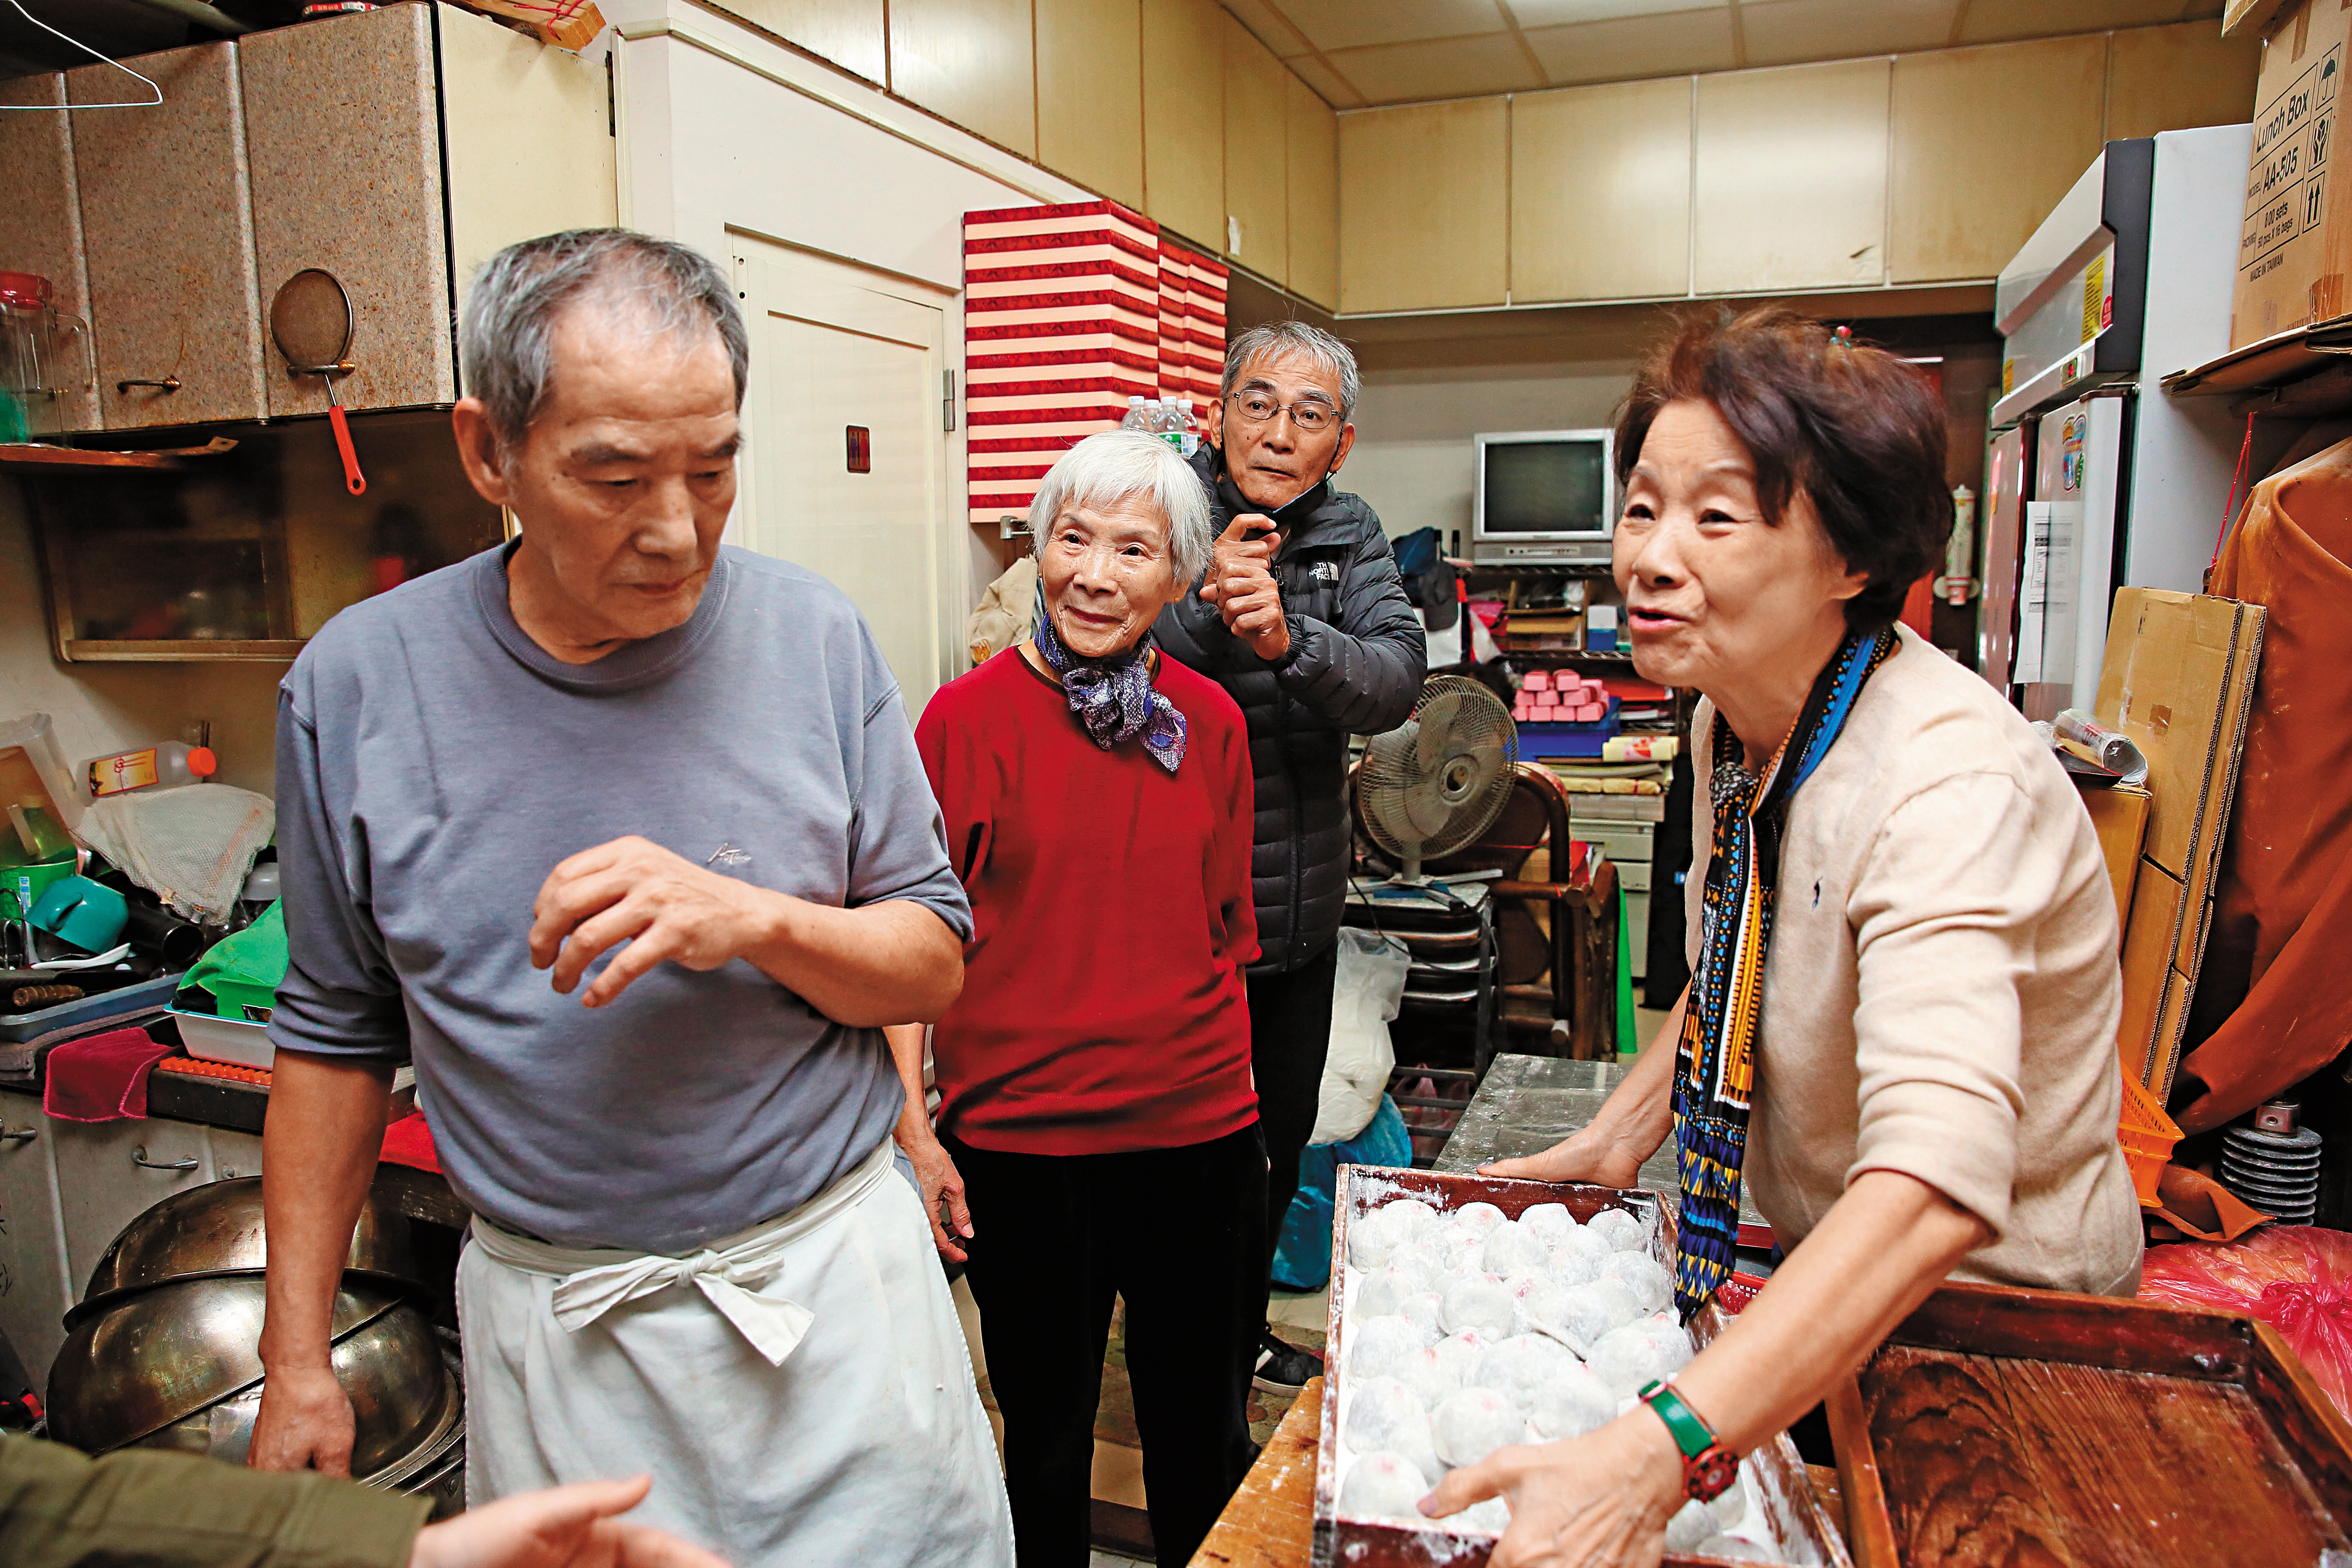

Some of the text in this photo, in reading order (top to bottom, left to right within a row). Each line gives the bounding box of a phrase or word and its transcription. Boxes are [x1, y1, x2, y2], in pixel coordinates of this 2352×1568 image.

[2256, 89, 2310, 153] Lunch Box
[2262, 146, 2299, 194] AA-505
[2276, 202, 2288, 221] sets
[2263, 233, 2271, 249] pcs
[2281, 218, 2293, 233] bags
[2250, 252, 2284, 282] MADE IN TAIWAN
